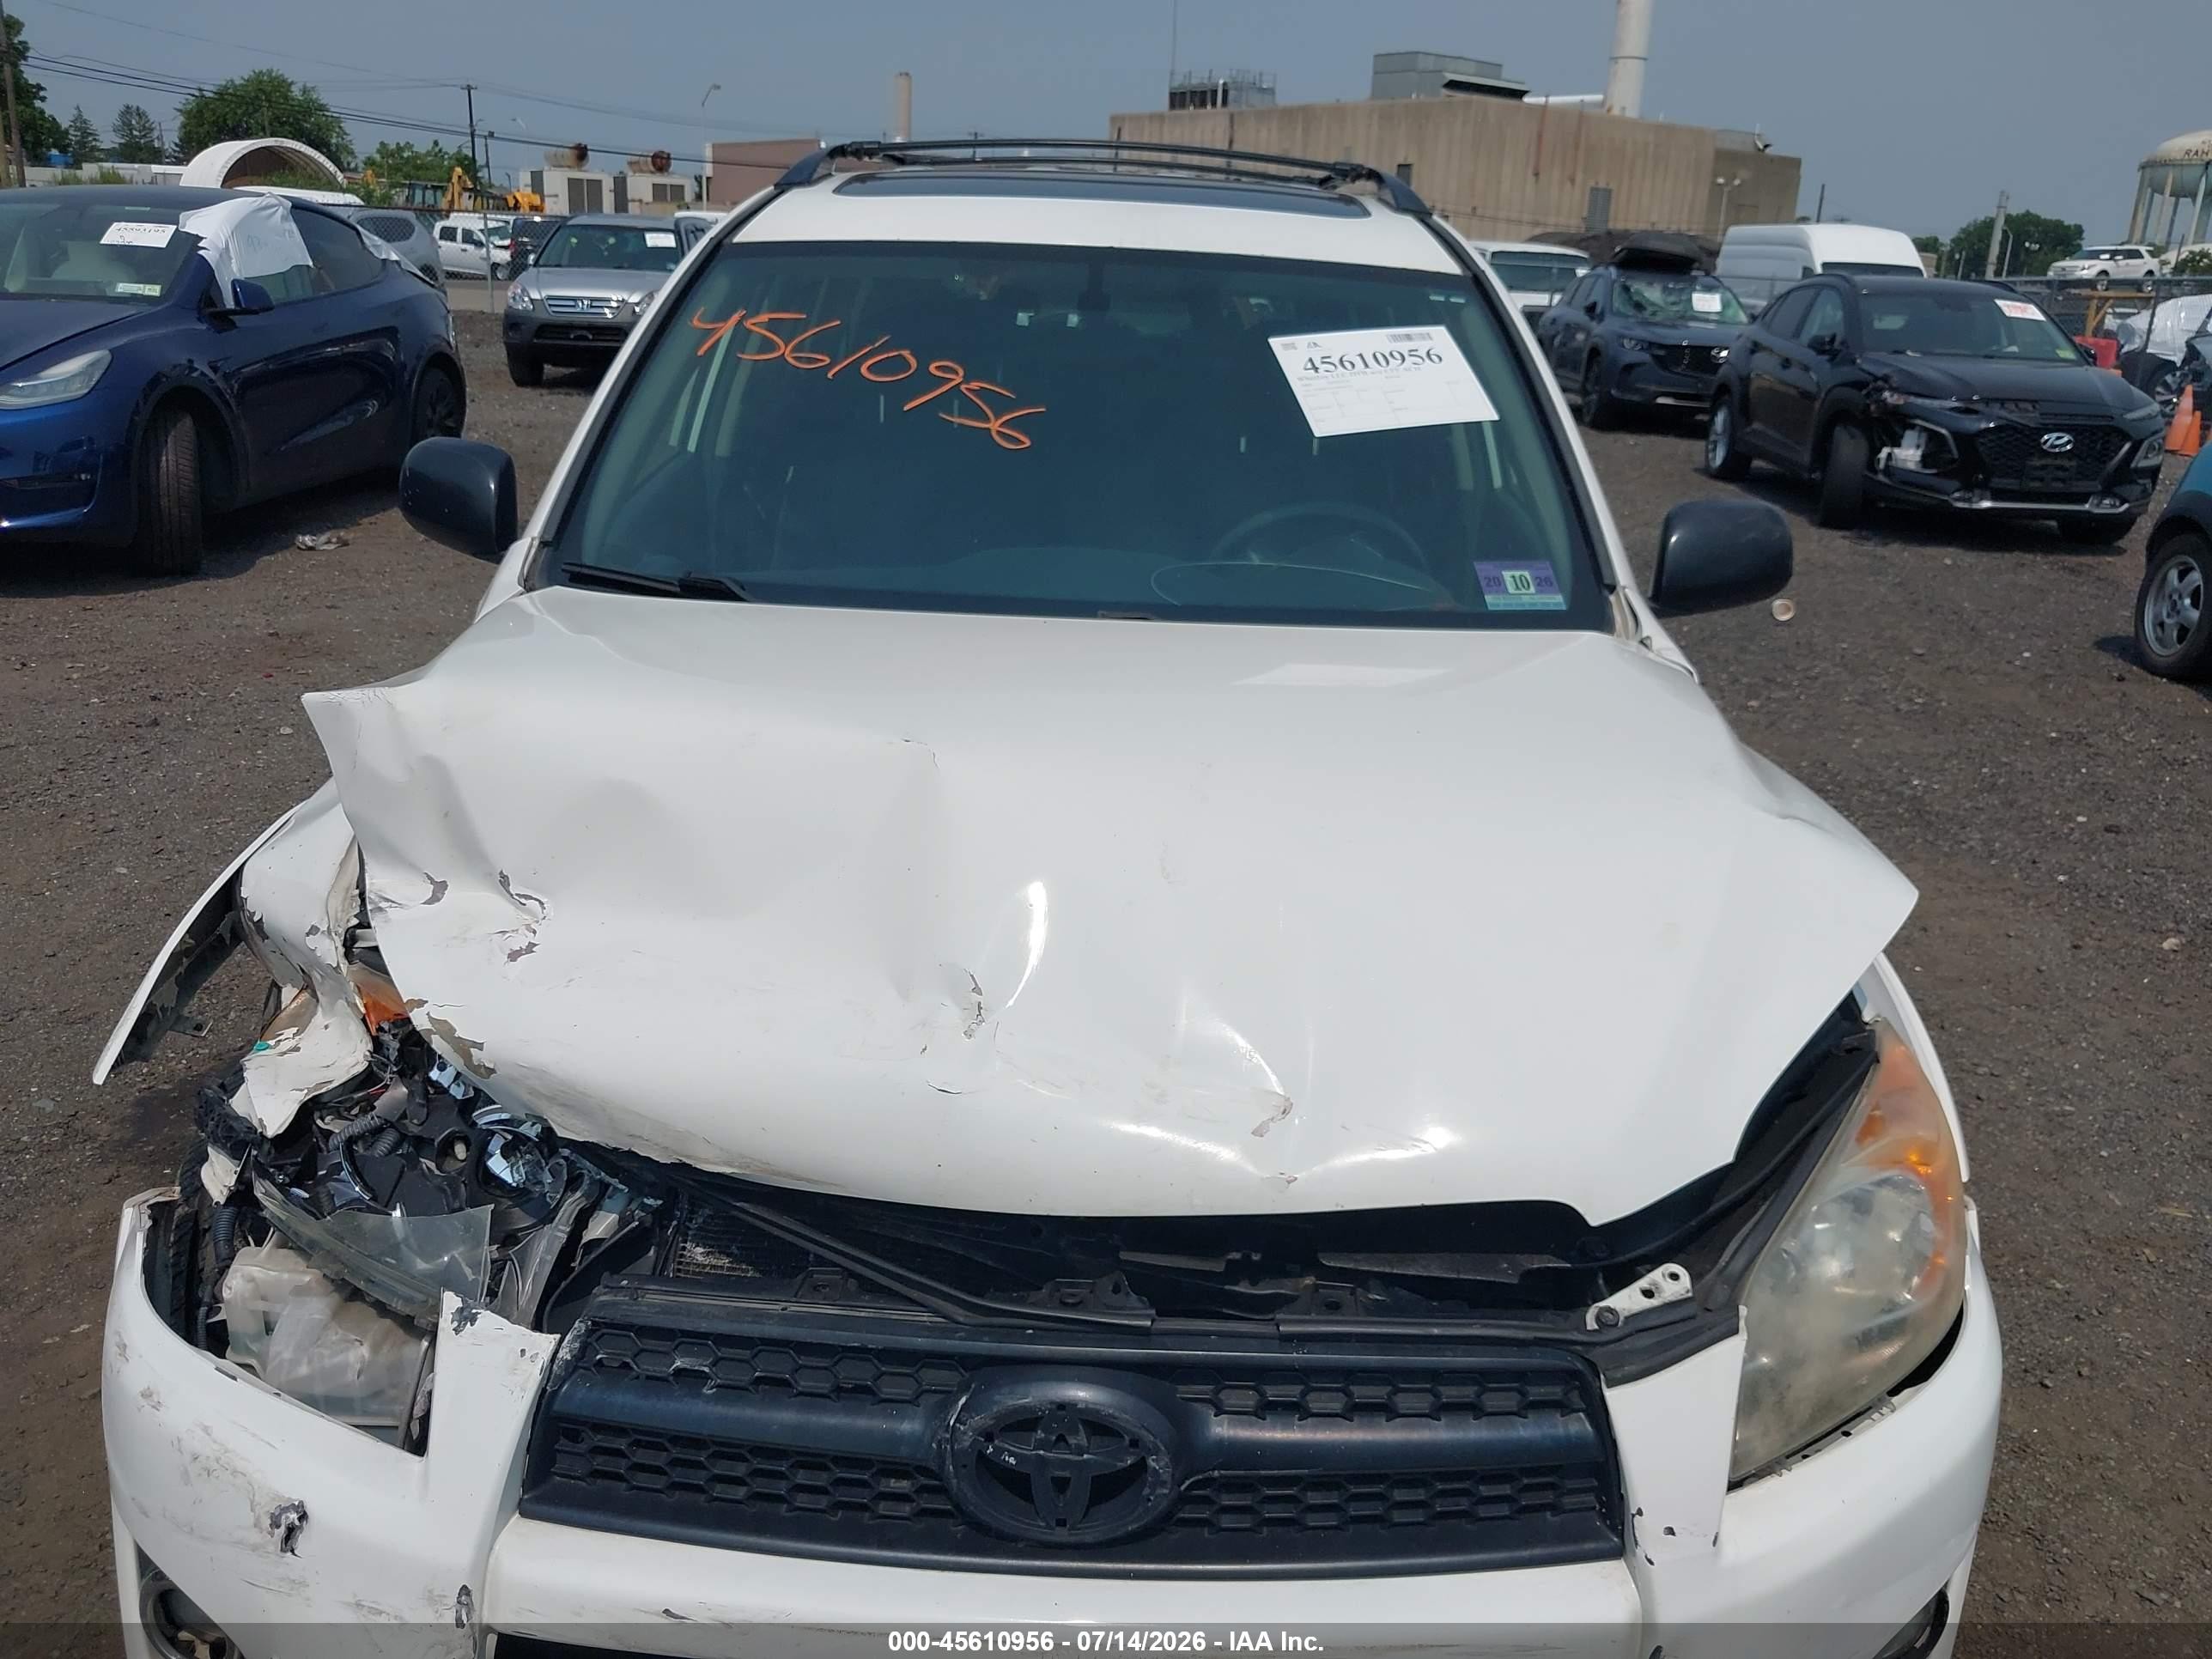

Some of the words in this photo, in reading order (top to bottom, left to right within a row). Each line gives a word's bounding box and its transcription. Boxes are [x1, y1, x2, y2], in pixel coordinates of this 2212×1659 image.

[1303, 347, 1443, 374] 45610956
[690, 307, 1047, 449] 45610956
[1484, 576, 1502, 587] 20
[1510, 574, 1531, 592] 10
[1535, 576, 1553, 587] 26
